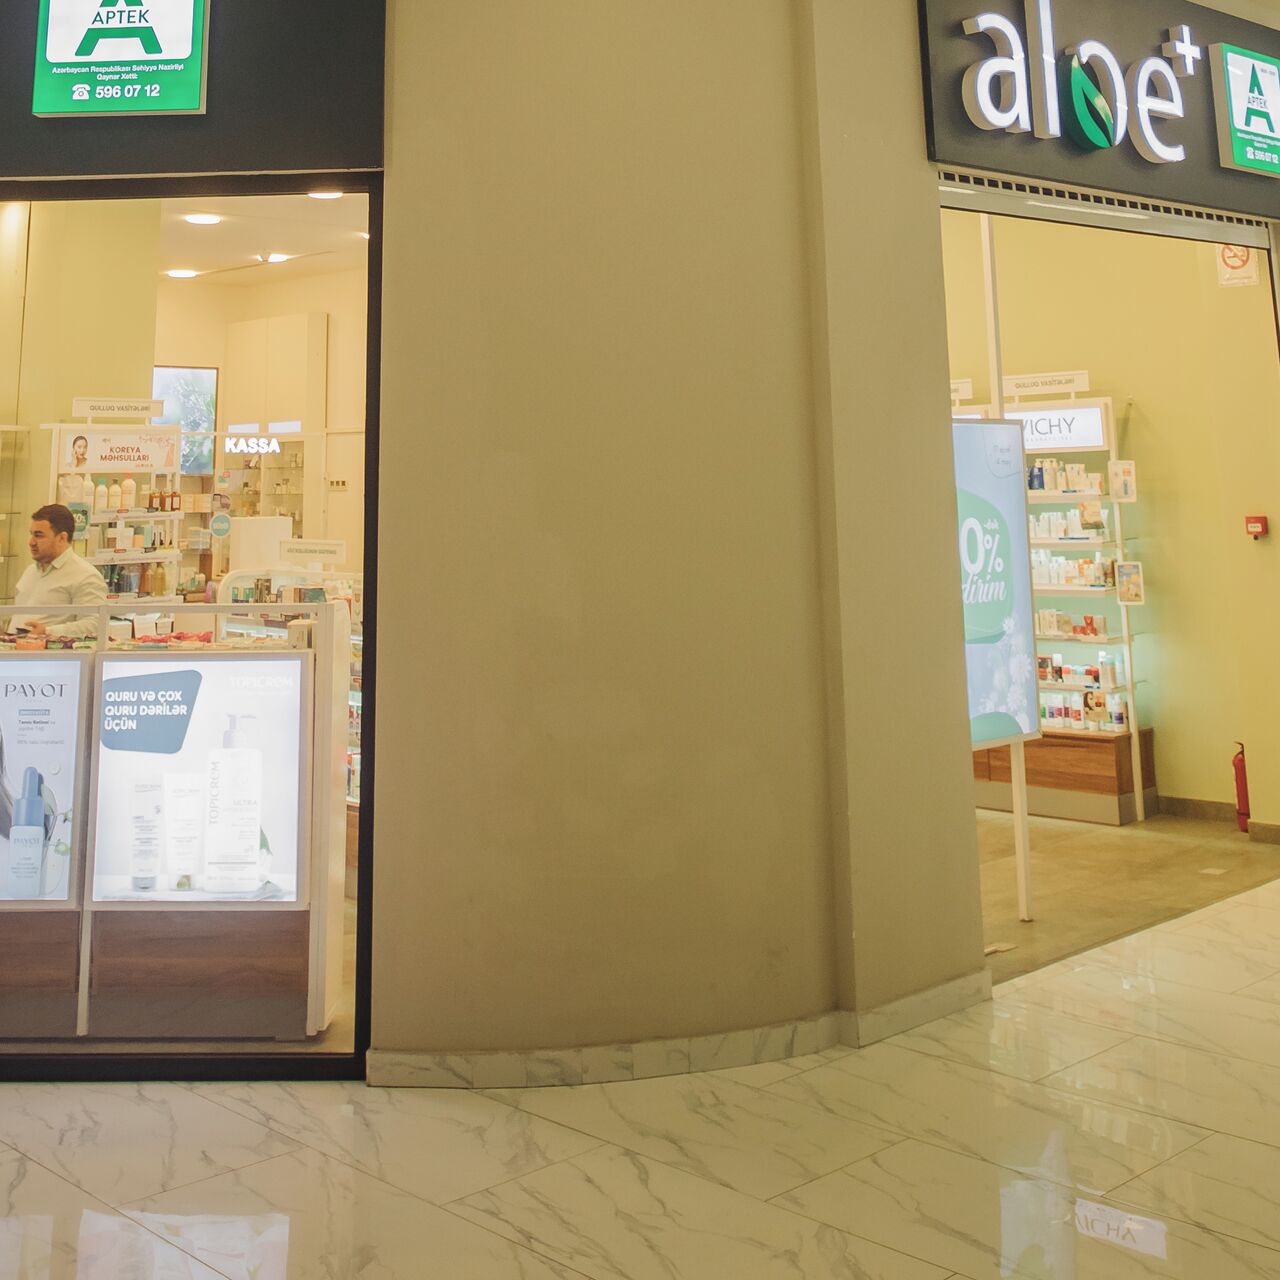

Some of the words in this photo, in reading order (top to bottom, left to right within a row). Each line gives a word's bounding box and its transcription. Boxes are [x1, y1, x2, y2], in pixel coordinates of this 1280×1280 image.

[91, 9, 150, 25] APTEK
[95, 85, 121, 98] 596
[124, 85, 141, 97] 07
[144, 84, 160, 96] 12
[109, 446, 141, 454] KOREYA
[224, 437, 280, 453] KASSA
[959, 517, 1004, 574] 0%
[5, 684, 68, 697] PAYOT
[105, 691, 138, 702] QURU
[158, 690, 182, 704] ÇOX
[104, 705, 137, 716] QURU
[104, 718, 137, 732] ÜÇÜN
